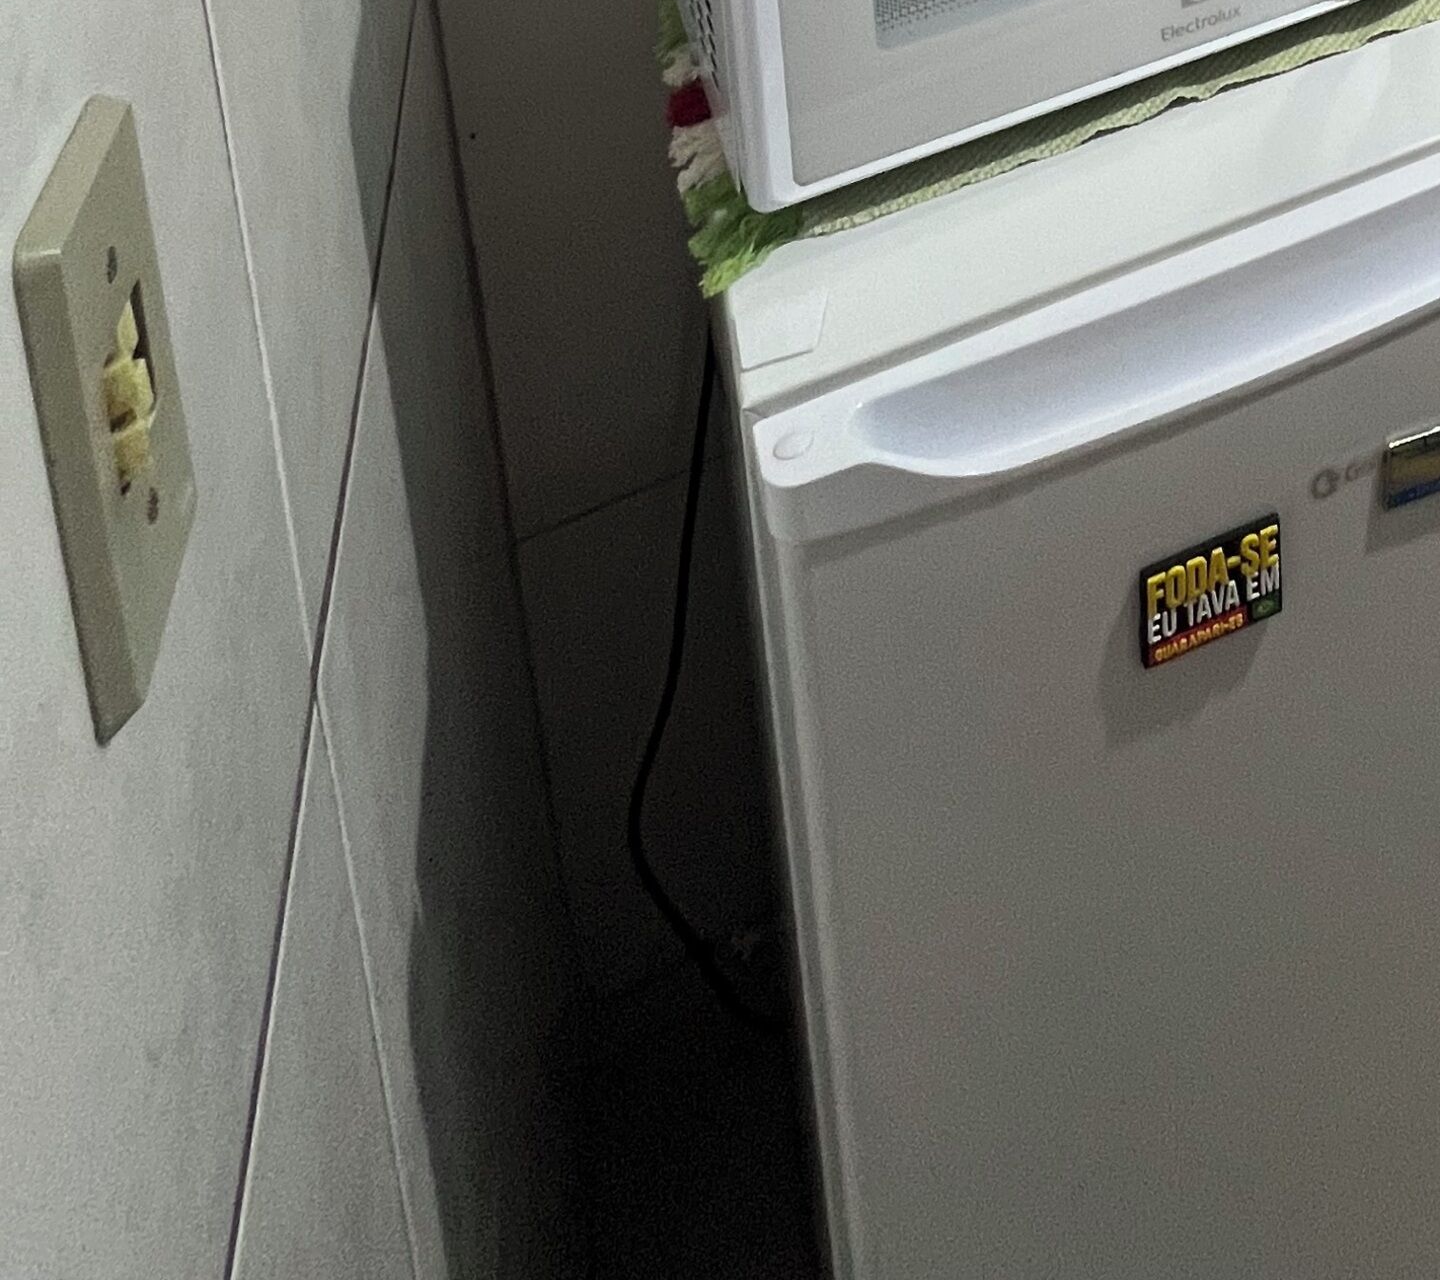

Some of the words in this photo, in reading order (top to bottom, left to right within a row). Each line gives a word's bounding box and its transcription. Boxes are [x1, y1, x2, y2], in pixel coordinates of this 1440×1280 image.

[1160, 6, 1241, 42] Electrolux
[1147, 524, 1279, 616] FODA-SE
[1148, 607, 1178, 645] EU
[1183, 579, 1241, 627] TAVA
[1246, 558, 1280, 601] EM
